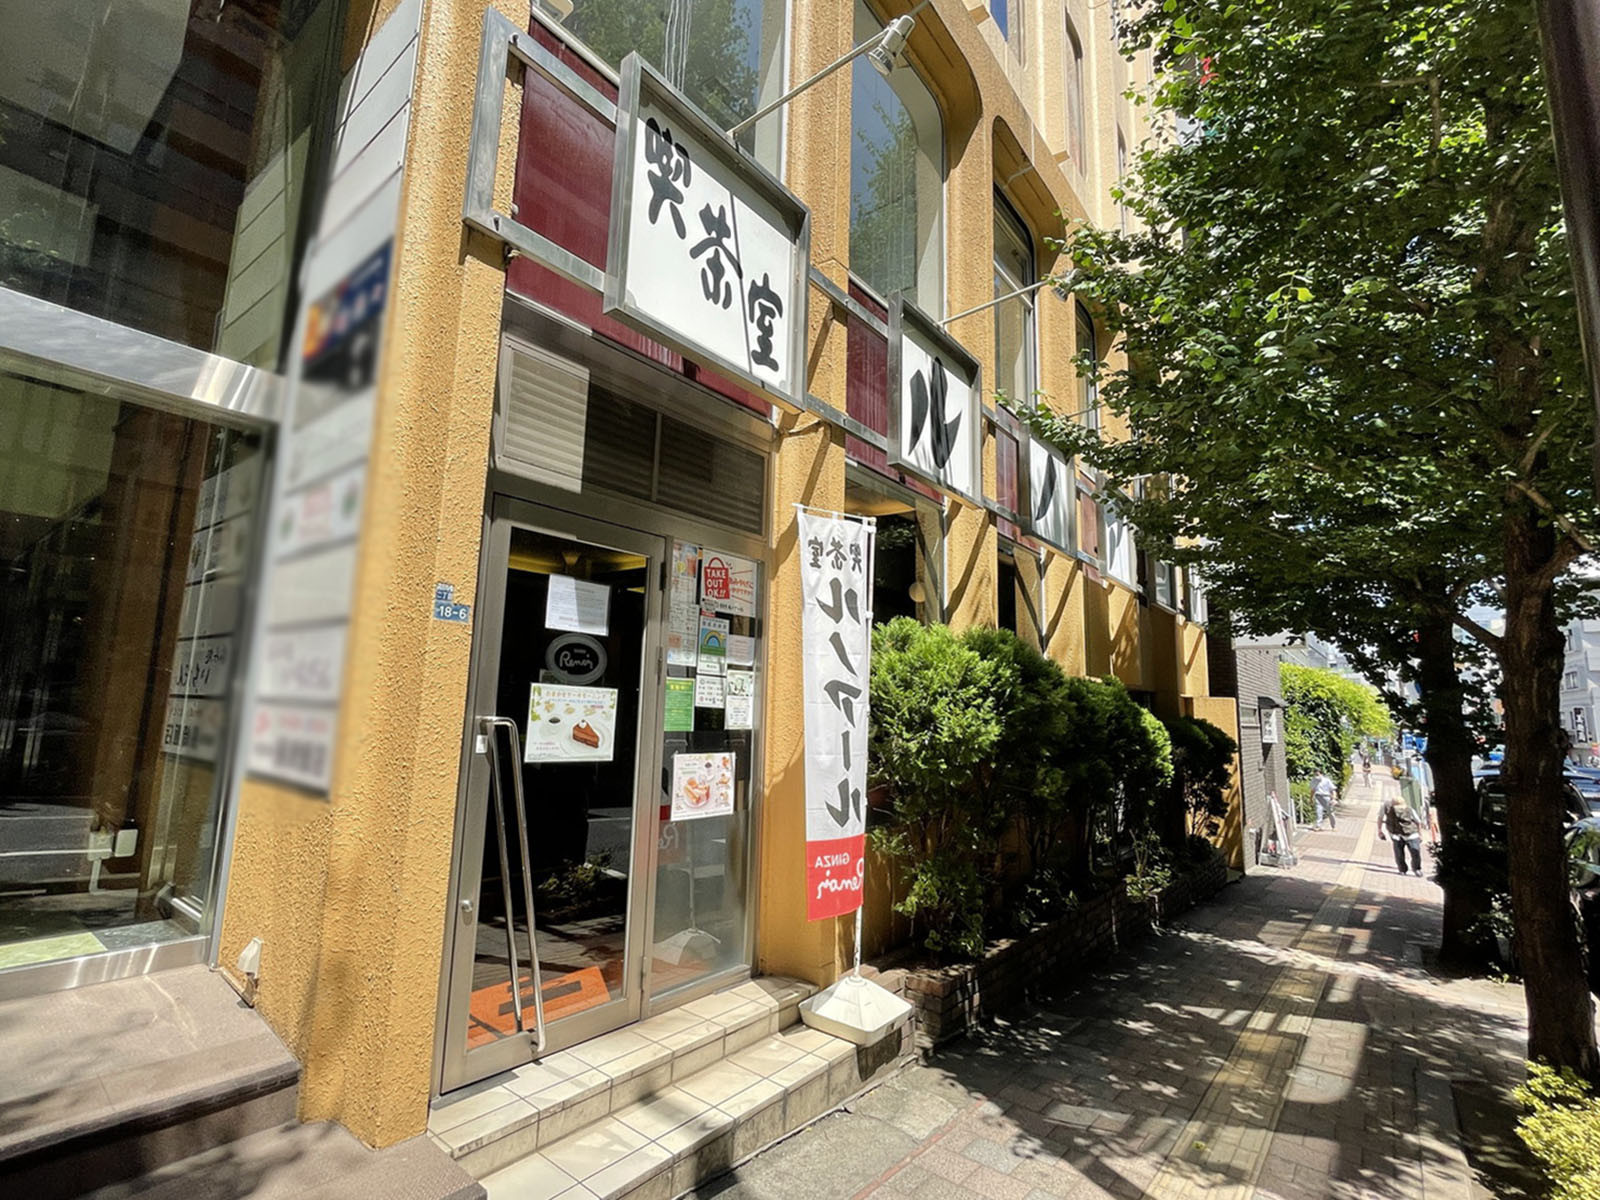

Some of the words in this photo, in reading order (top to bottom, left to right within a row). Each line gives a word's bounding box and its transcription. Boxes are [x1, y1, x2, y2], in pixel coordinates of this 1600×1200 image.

[645, 117, 783, 371] 喫茶室
[706, 569, 727, 579] TAKE
[706, 579, 724, 588] OUT
